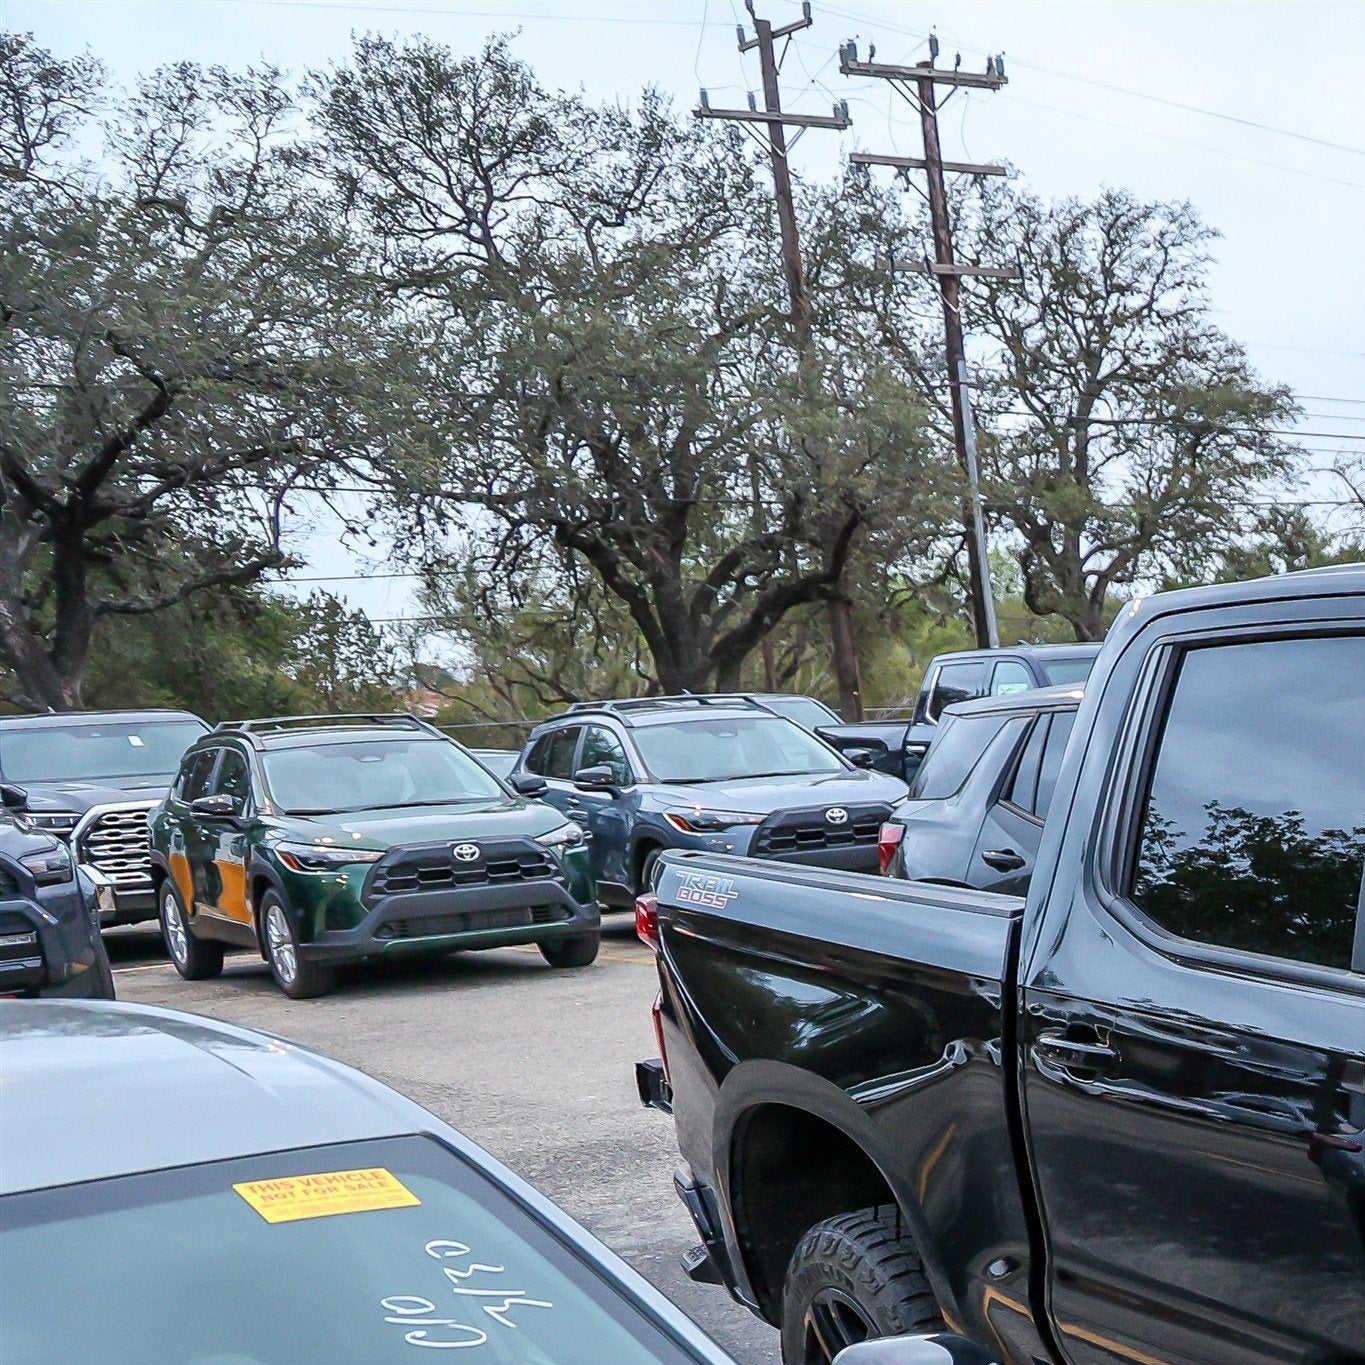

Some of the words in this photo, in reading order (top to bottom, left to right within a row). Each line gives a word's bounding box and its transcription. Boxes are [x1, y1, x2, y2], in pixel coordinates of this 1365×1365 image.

[676, 871, 739, 898] TRAIL
[676, 888, 728, 908] BOSS
[245, 1181, 296, 1195] THIS
[298, 1170, 387, 1188] VEHICLE
[260, 1190, 297, 1202] NOT
[303, 1185, 339, 1197] FOR
[346, 1181, 389, 1192] SALE
